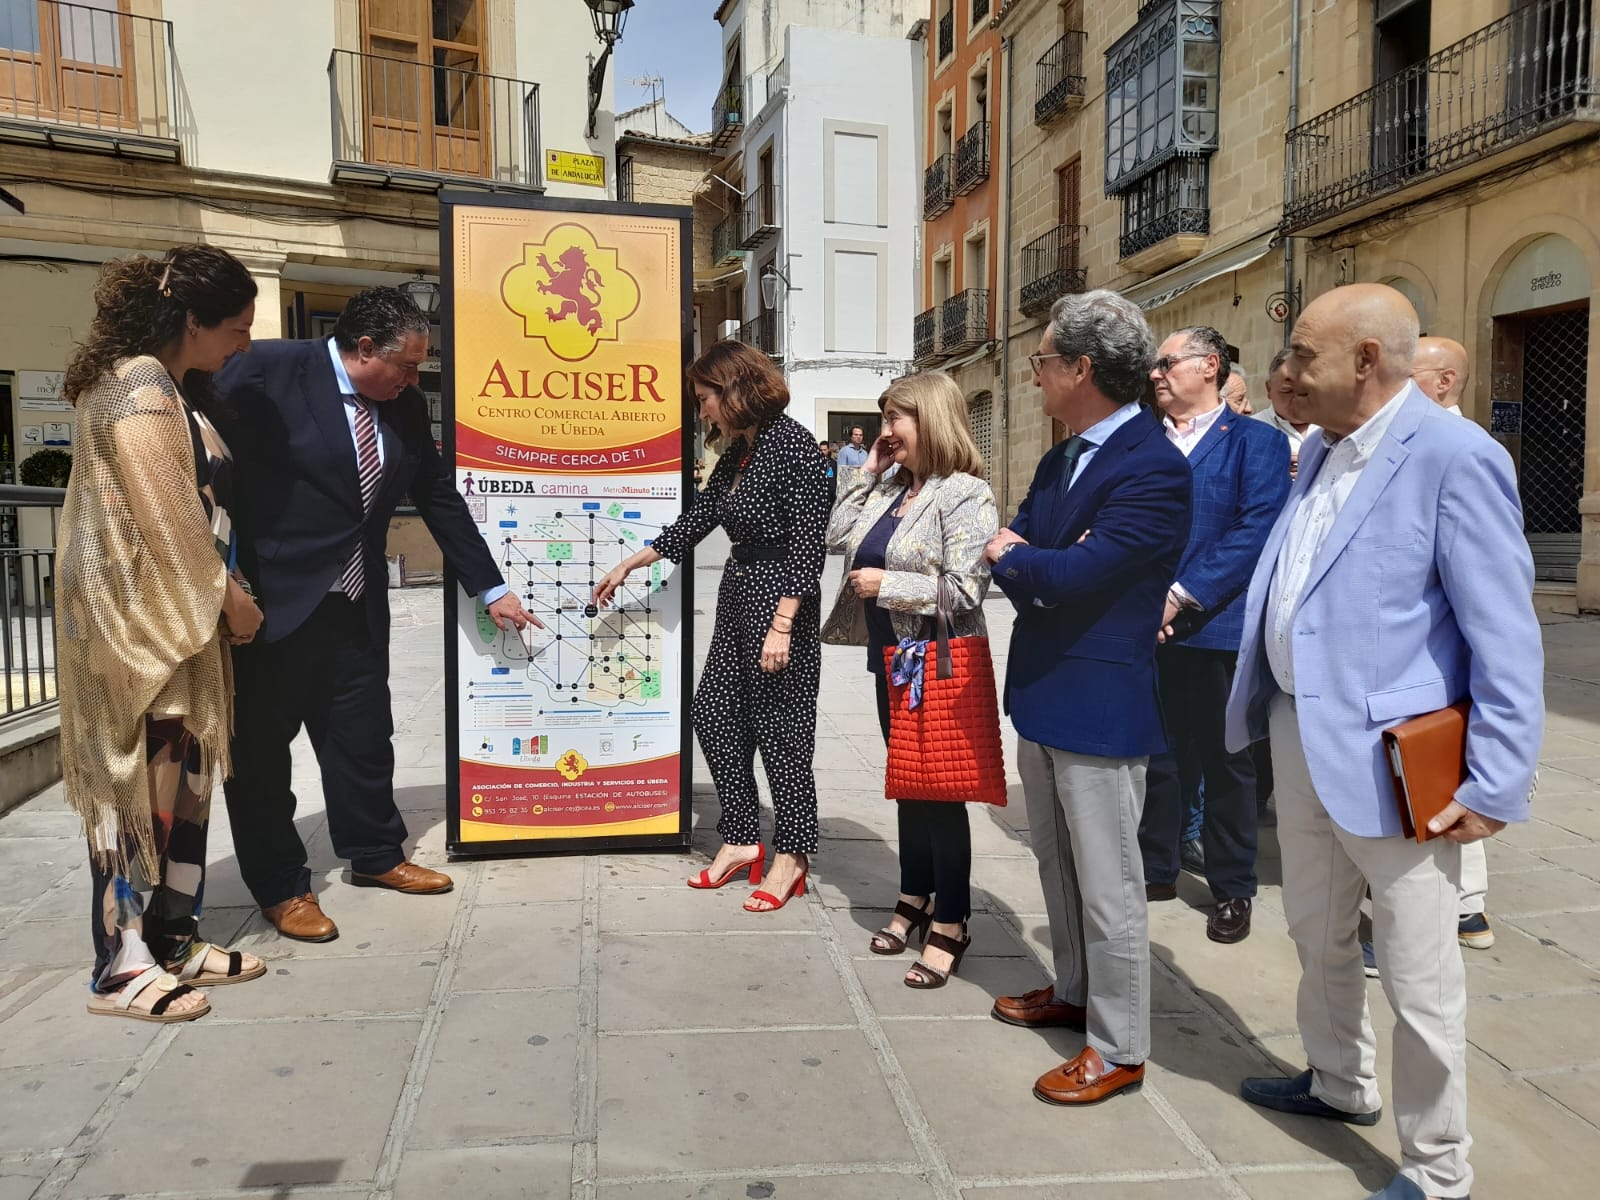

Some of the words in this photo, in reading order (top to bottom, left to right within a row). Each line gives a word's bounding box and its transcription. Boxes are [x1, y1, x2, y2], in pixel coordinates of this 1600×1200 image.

[572, 157, 594, 167] PLAZA
[551, 168, 560, 176] DE
[477, 358, 666, 404] ALCISER
[477, 405, 532, 419] CENTRO
[534, 406, 609, 422] COMERCIAL
[611, 409, 666, 423] ABIERTO
[541, 424, 557, 436] DE
[560, 420, 605, 437] ÚBEDA
[495, 444, 558, 465] SIEMPRE
[560, 453, 609, 466] CERCA
[611, 451, 630, 464] DE
[632, 447, 646, 459] TI
[478, 476, 536, 494] ÚBEDA
[541, 482, 589, 495] camina
[602, 486, 651, 495] MetroMinuto
[602, 779, 635, 787] SERVICIOS
[575, 791, 609, 799] ESTACIÓN
